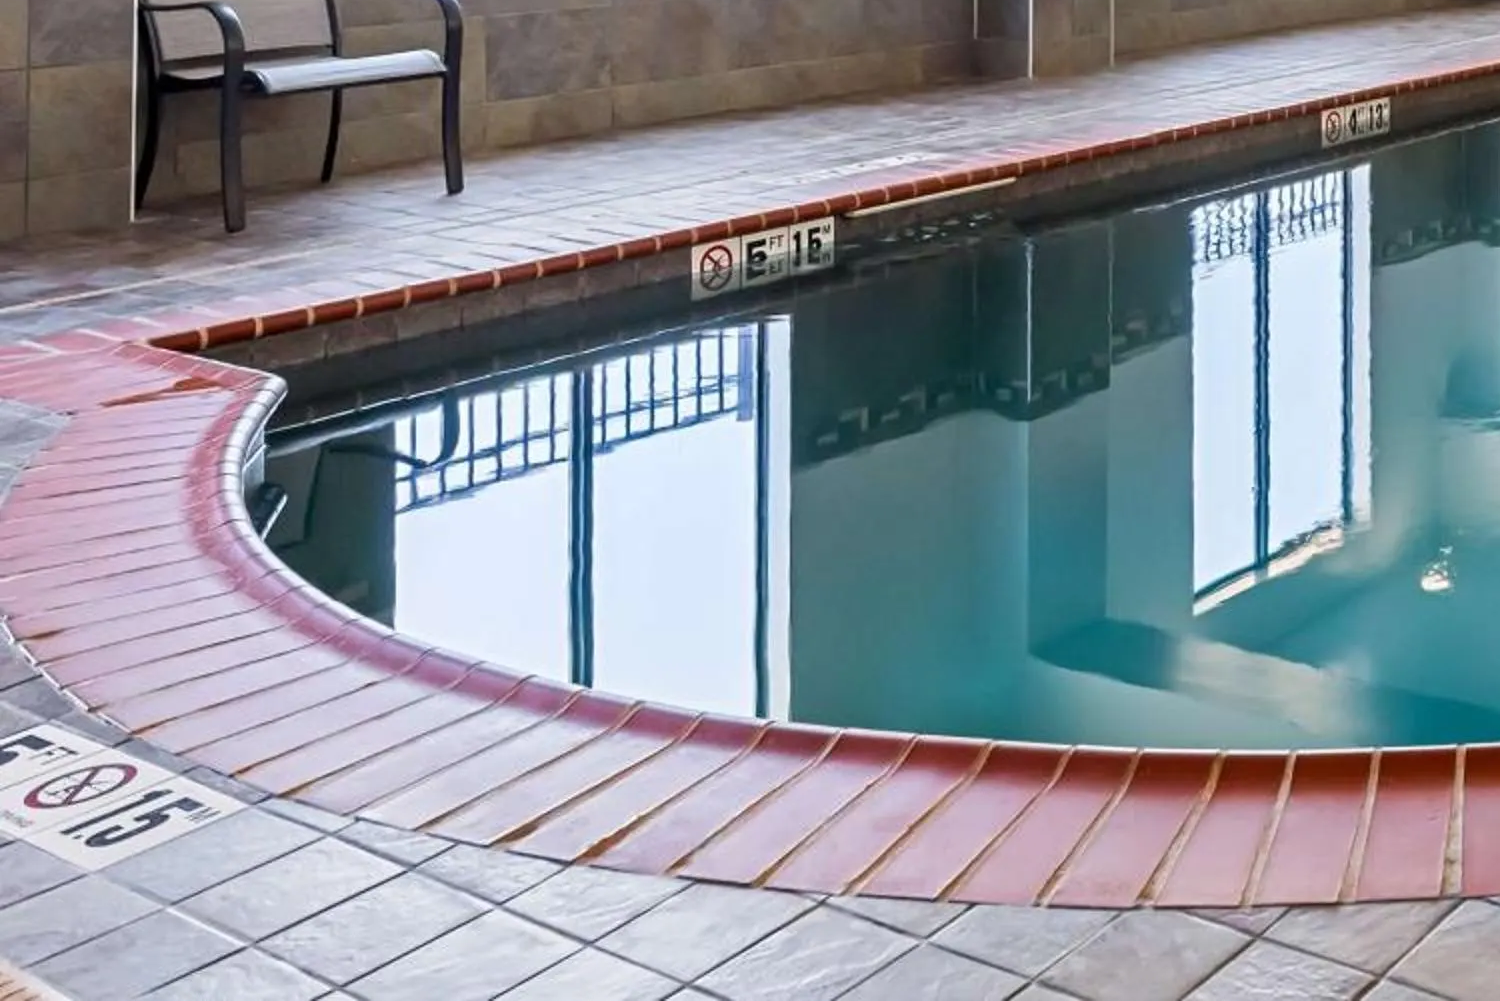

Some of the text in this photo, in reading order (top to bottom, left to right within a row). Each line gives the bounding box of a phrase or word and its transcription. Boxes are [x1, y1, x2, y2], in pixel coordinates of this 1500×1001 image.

[769, 234, 784, 250] FT
[28, 746, 79, 766] FT
[60, 789, 204, 847] 1.5
